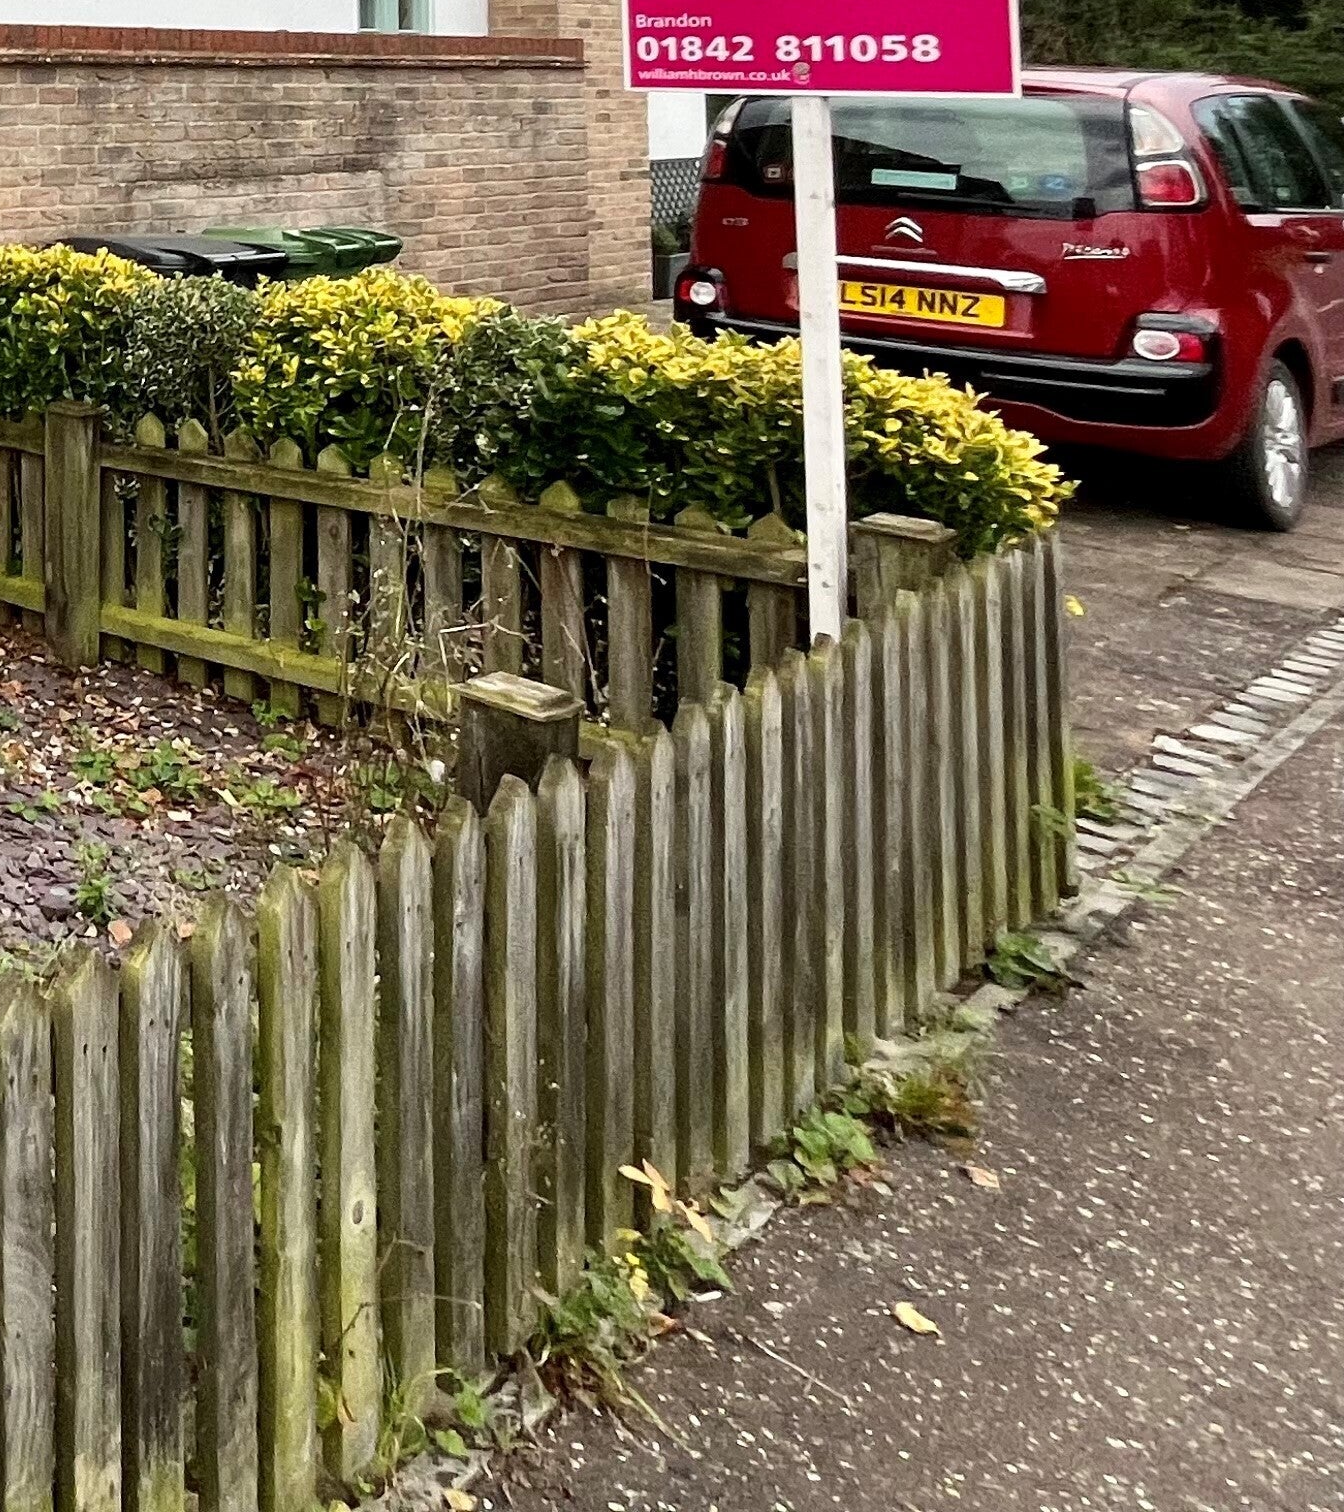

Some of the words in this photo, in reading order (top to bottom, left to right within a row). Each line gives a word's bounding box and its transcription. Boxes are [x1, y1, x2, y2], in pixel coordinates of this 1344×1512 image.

[635, 13, 712, 28] Brandon
[637, 35, 754, 62] 01842
[775, 34, 941, 62] 811058
[638, 68, 791, 81] williamhbrown.co.uk
[841, 283, 906, 309] LS14
[917, 290, 980, 318] NNZ
